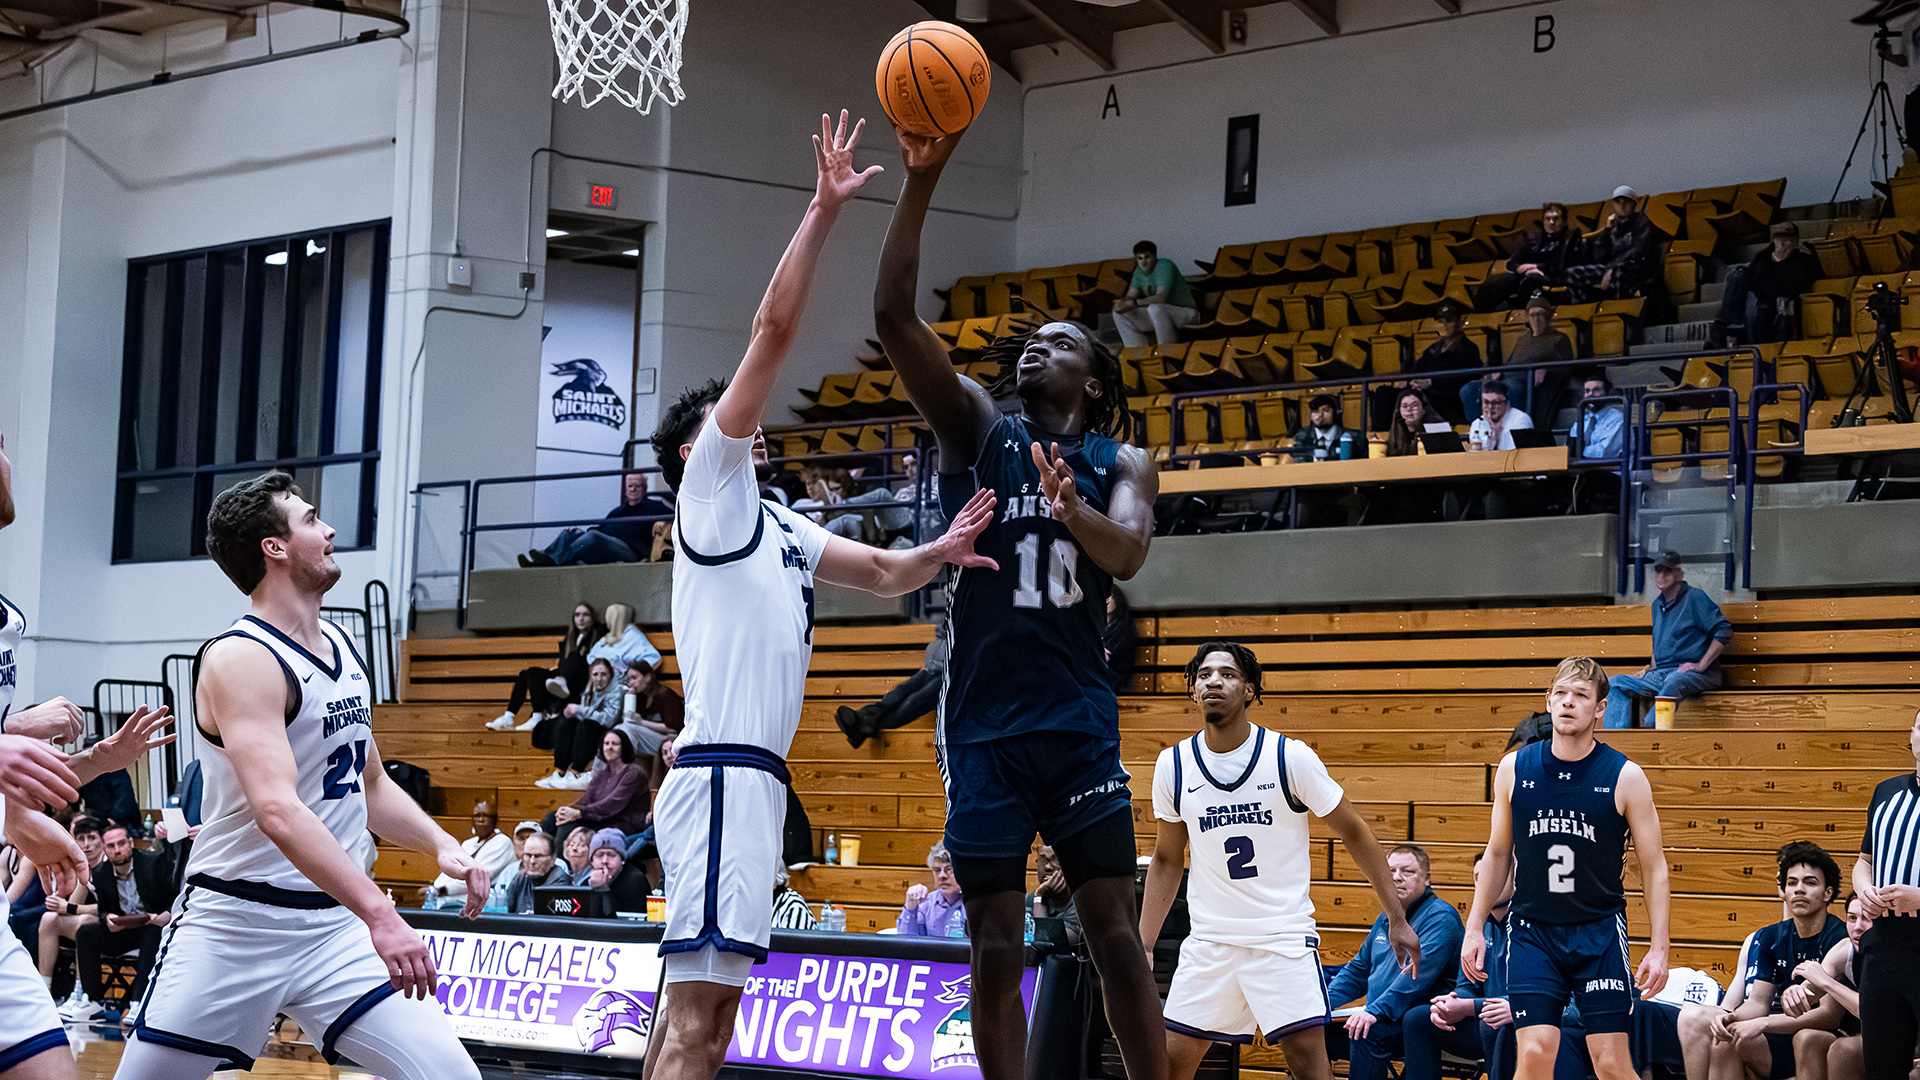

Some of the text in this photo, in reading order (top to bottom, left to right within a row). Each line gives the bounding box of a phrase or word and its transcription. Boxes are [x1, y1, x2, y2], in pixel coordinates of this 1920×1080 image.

[1534, 15, 1556, 53] B
[1102, 84, 1120, 120] A
[592, 186, 614, 206] EXIT
[562, 389, 616, 404] SAINT
[1013, 532, 1084, 610] 10
[326, 695, 363, 714] SAINT
[321, 739, 367, 801] 21
[1205, 802, 1262, 815] SAINT
[1537, 809, 1586, 821] SAINT
[1528, 818, 1597, 843] ANSELM
[1223, 836, 1258, 880] 2
[1547, 843, 1575, 894] 2
[554, 898, 572, 914] POSS
[469, 938, 621, 985] MICHAEL'S
[1711, 962, 1725, 972] 20
[743, 958, 931, 1008] OF THE PURPLE
[1585, 978, 1625, 993] HAWKS
[733, 998, 932, 1073] NIGHTS
